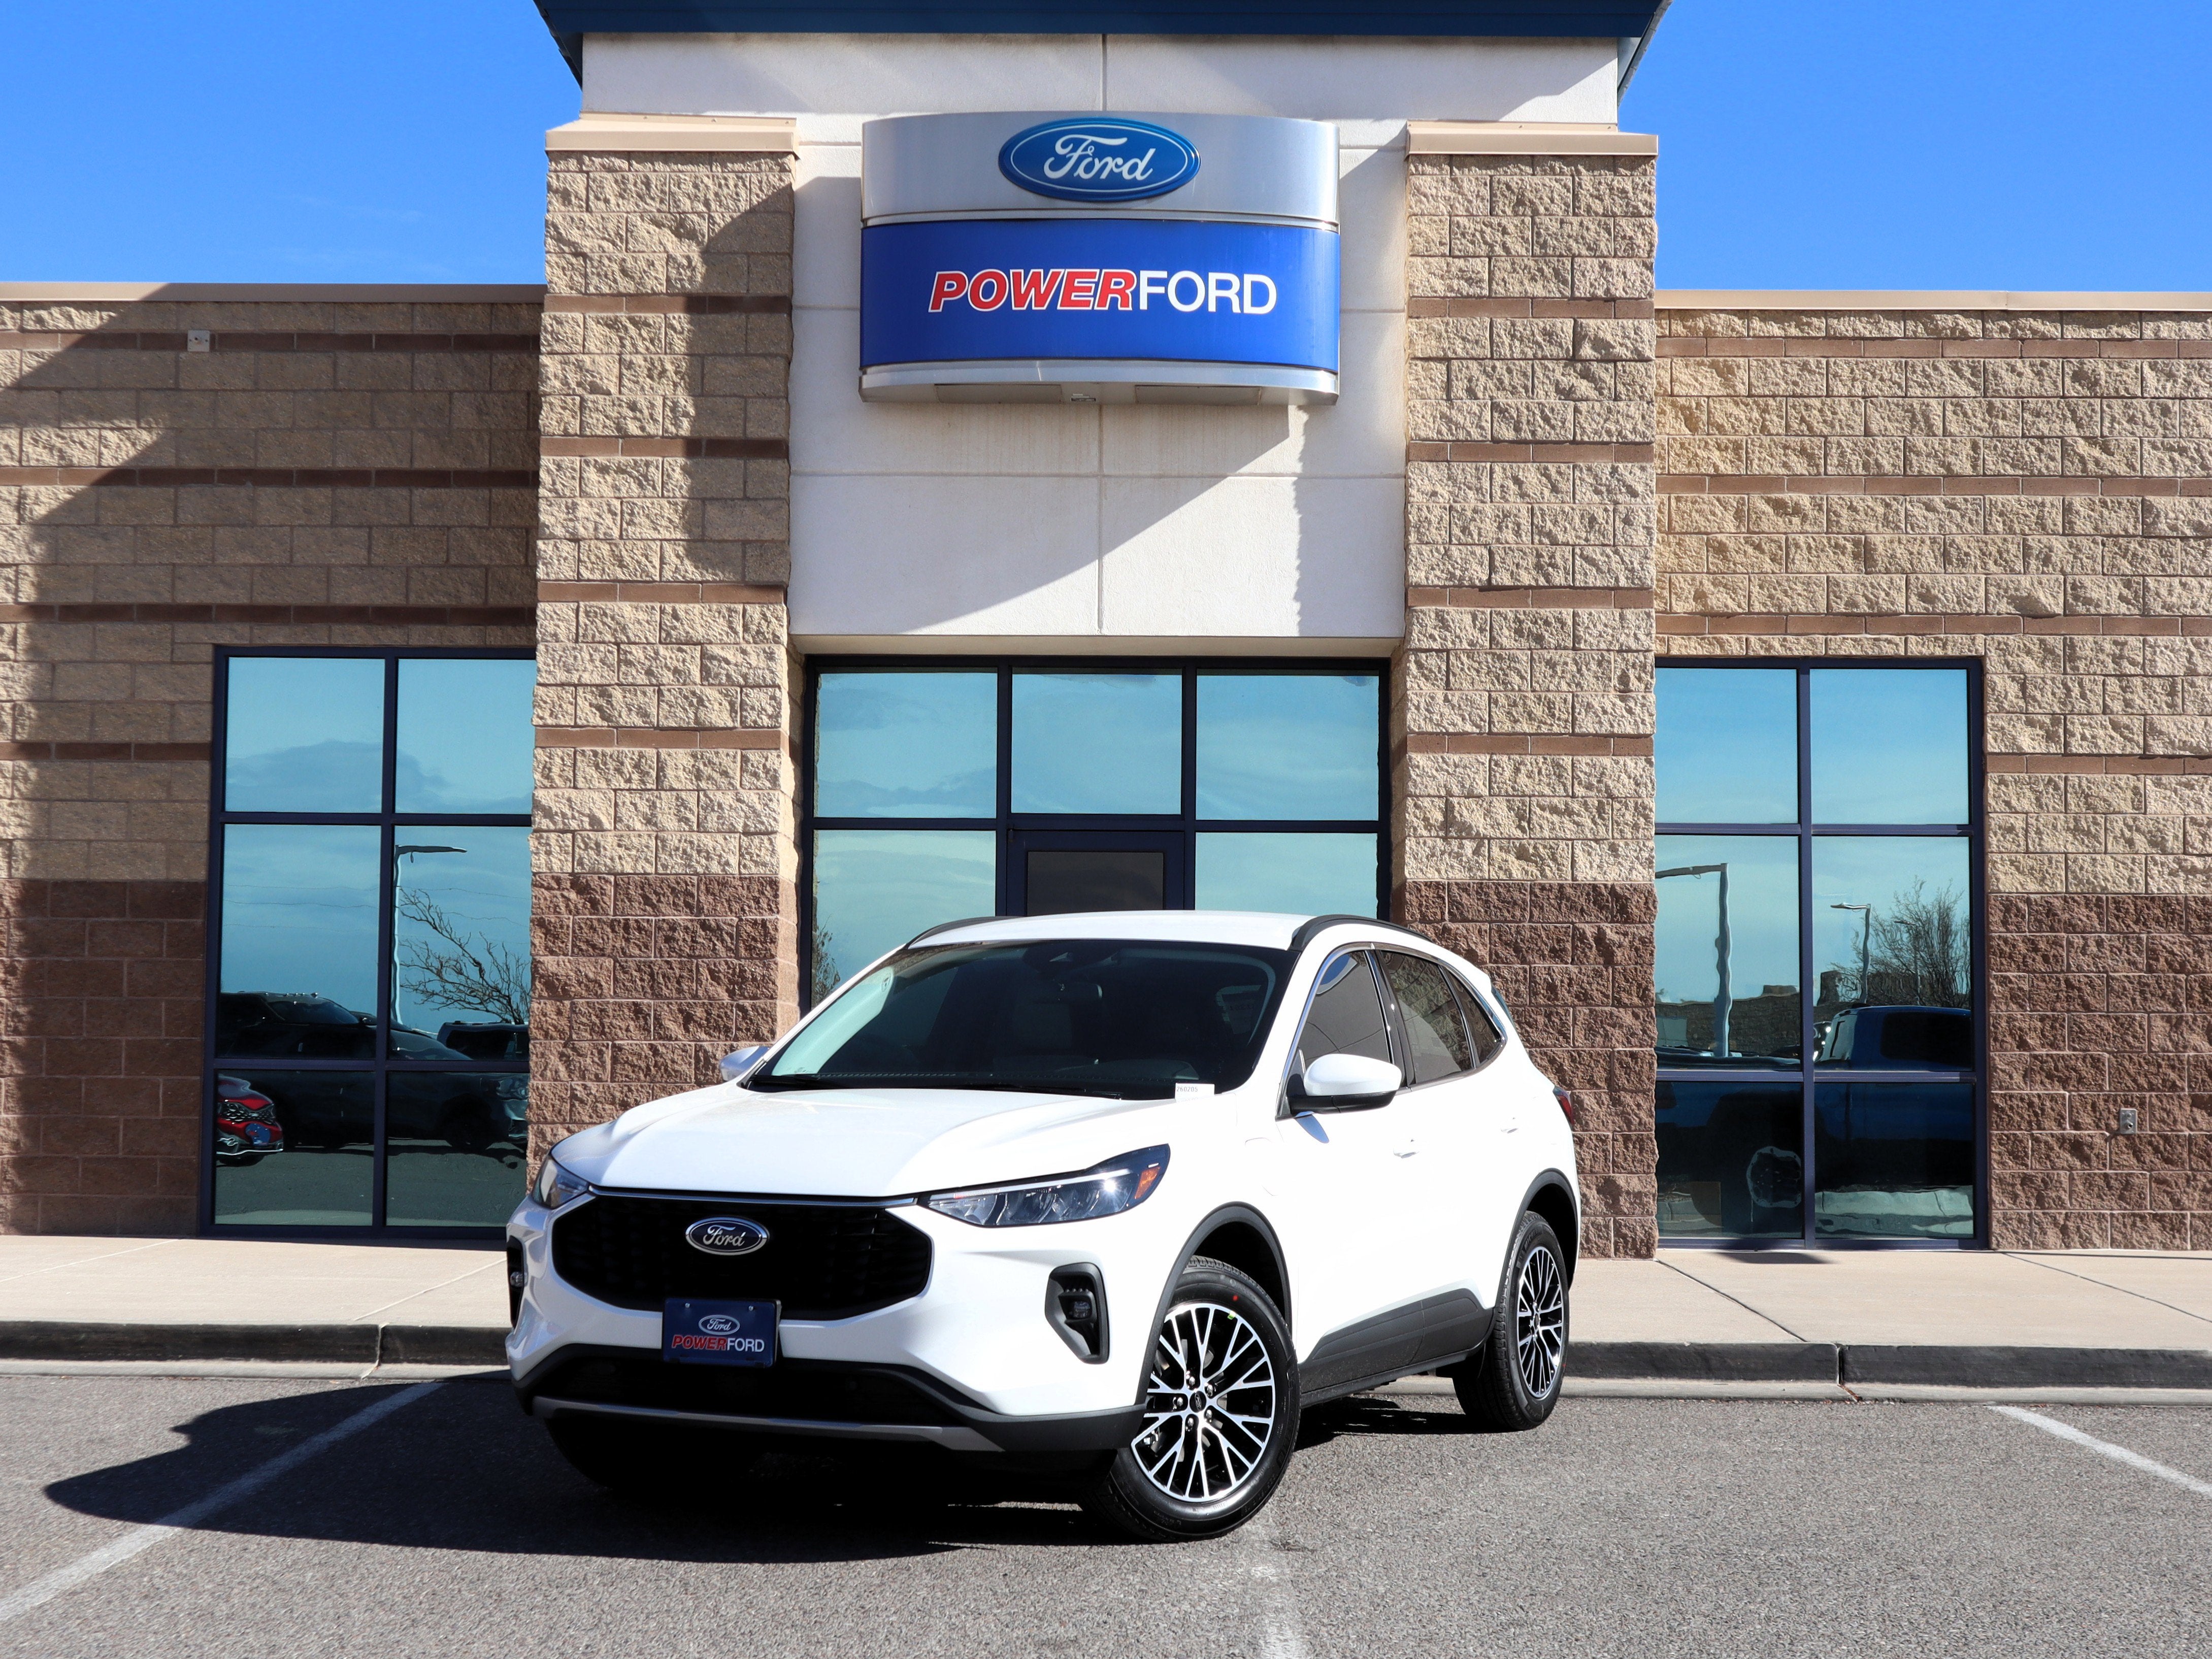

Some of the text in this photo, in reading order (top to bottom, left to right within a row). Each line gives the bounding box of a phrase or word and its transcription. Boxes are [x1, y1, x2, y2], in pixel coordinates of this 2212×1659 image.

[1043, 134, 1157, 181] Ford
[928, 268, 1277, 315] POWERFORD
[702, 1224, 745, 1247] Ford
[707, 1319, 732, 1331] Ford
[672, 1335, 765, 1352] POWERFORD
